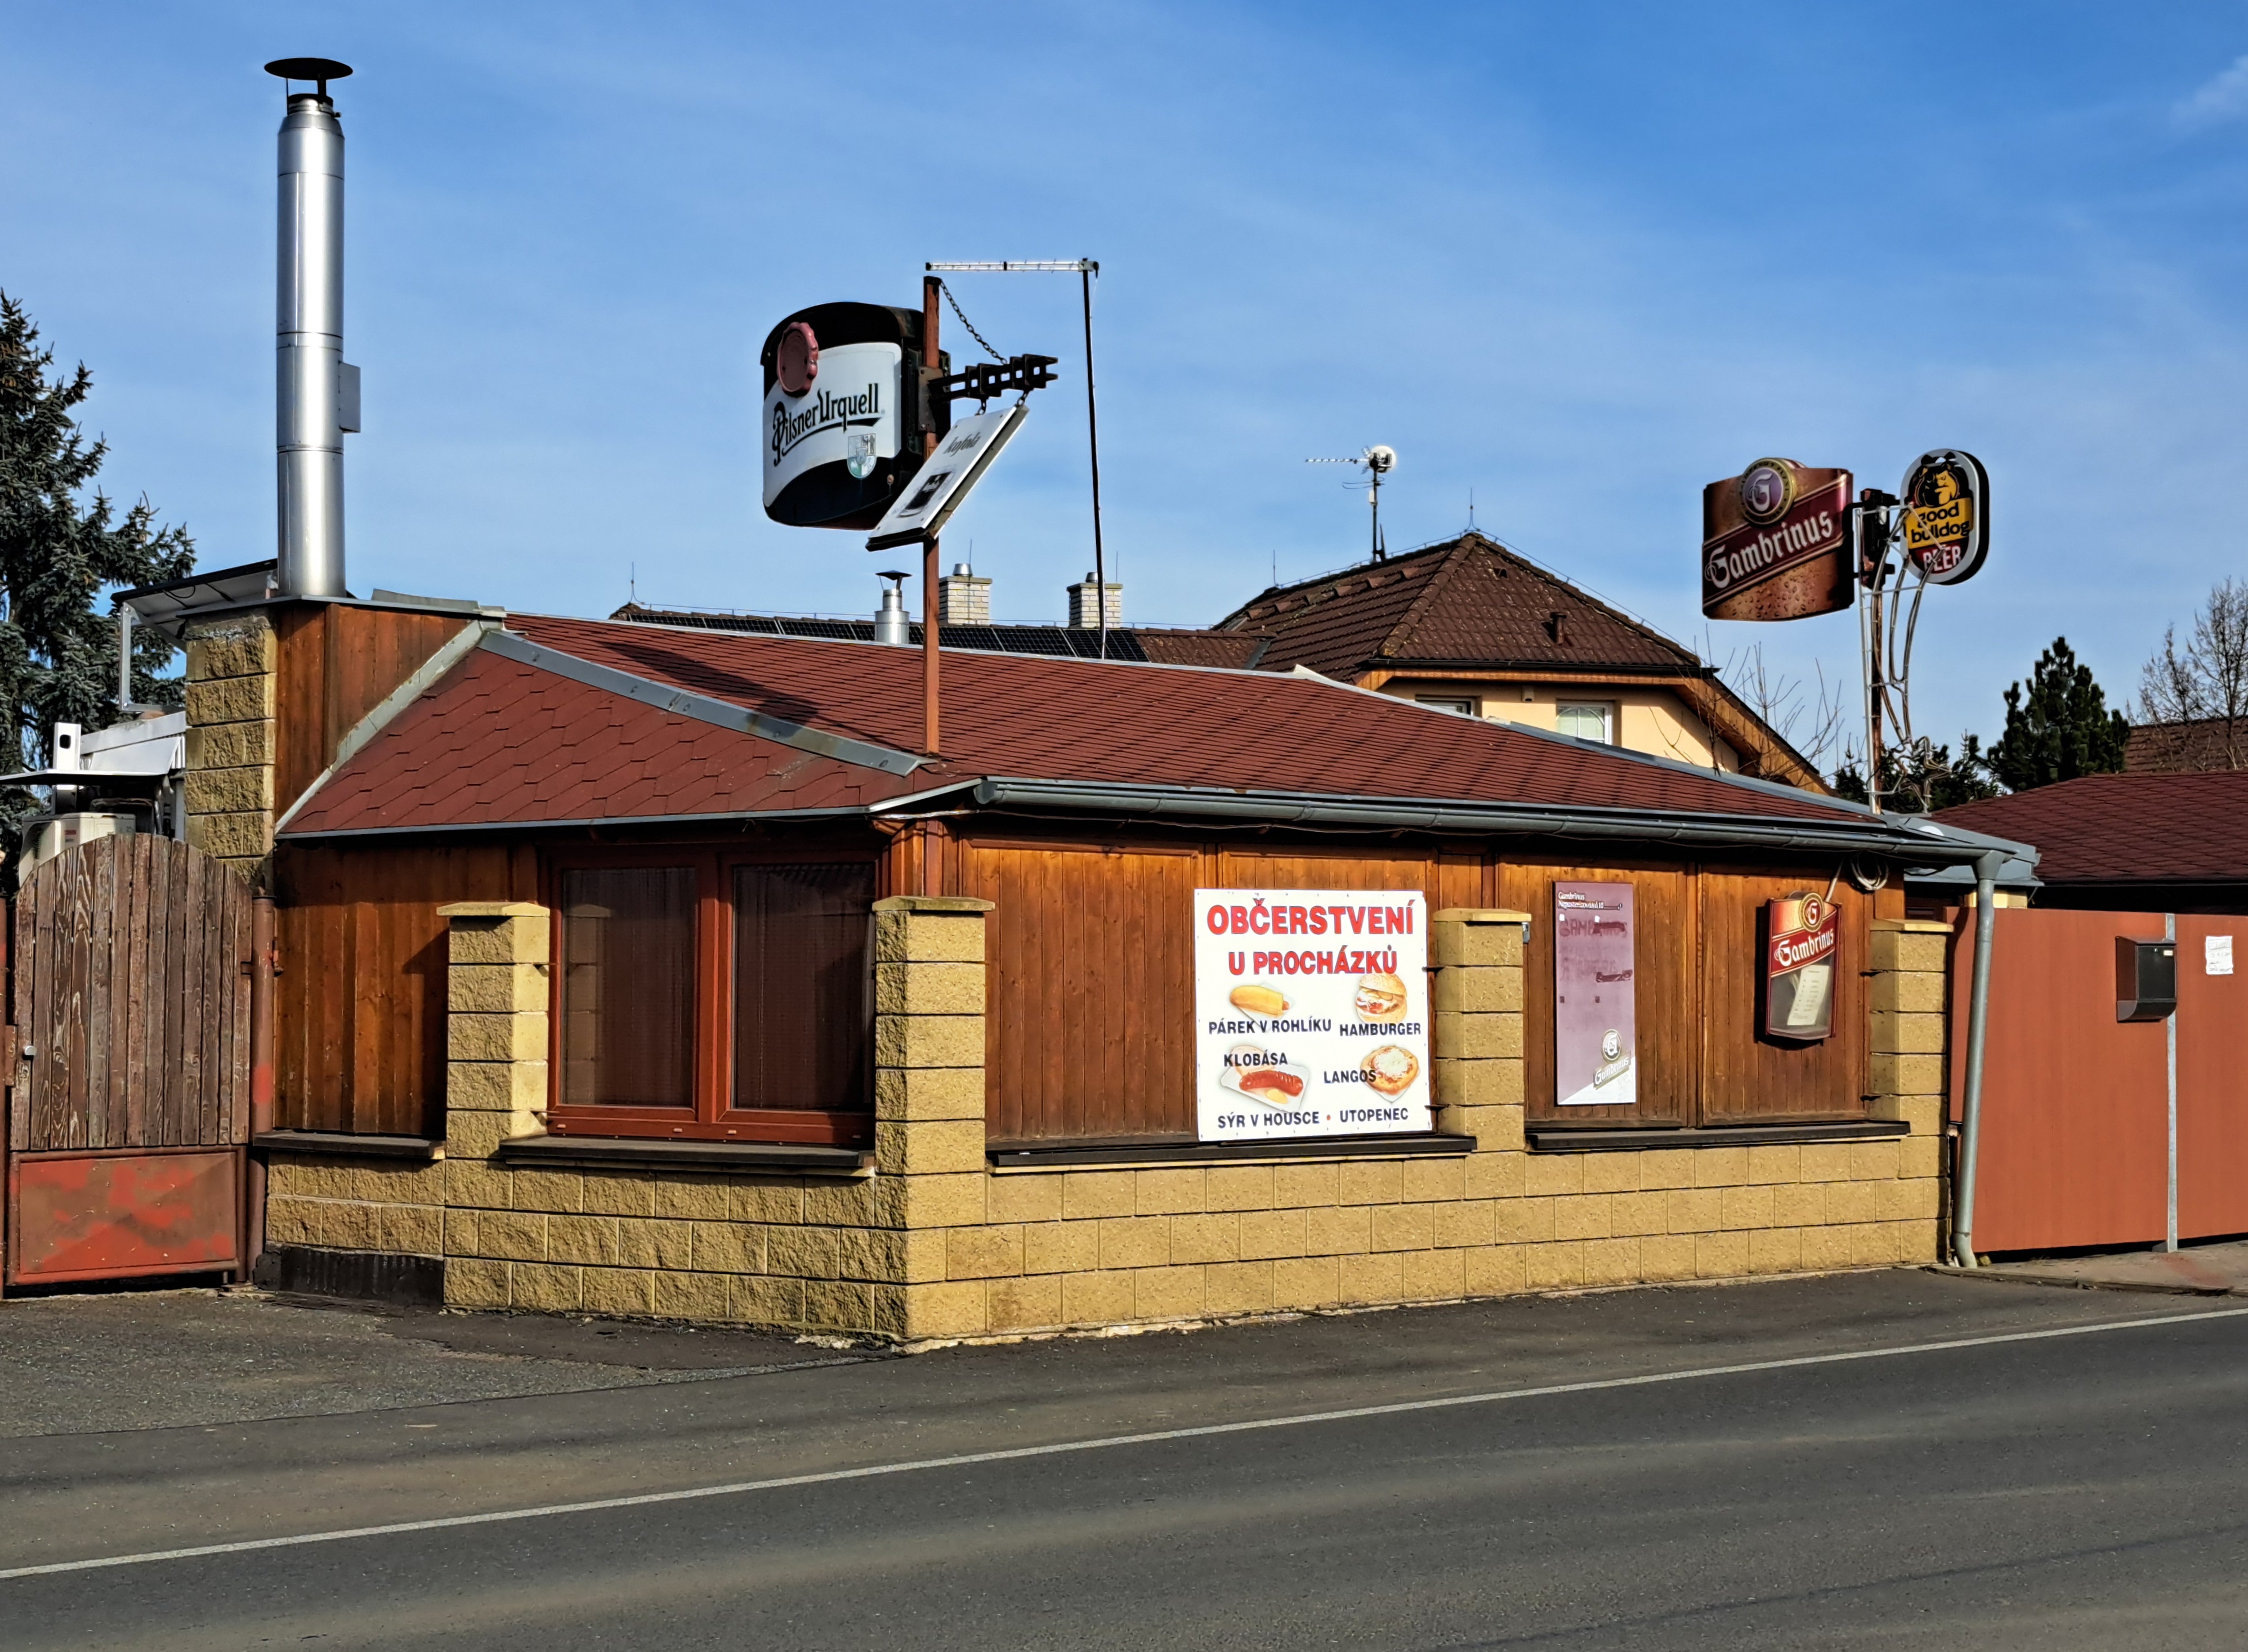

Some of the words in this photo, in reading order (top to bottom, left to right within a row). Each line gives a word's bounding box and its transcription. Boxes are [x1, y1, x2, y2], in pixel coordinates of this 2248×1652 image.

[772, 401, 819, 467] Pilsner
[817, 383, 879, 433] Urquell
[1918, 502, 1960, 528] good
[1911, 520, 1969, 544] bulldog
[1705, 511, 1833, 588] Gambrinus
[1558, 891, 1585, 901] Gambrinus
[1206, 898, 1416, 935] OBČERSTVENÍ
[1775, 929, 1834, 966] Gambrinus
[1228, 951, 1246, 975] U
[1253, 945, 1398, 975] PROCHÁZKŮ
[1209, 1019, 1255, 1035] PÁREK
[1259, 1020, 1268, 1033] V
[1272, 1015, 1332, 1033] ROHLÍKU
[1339, 1022, 1422, 1037] HAMBURGER
[1223, 1049, 1288, 1067] KLOBÁSA
[1324, 1069, 1376, 1084] LANGOS
[1594, 1056, 1629, 1085] Gambrinus
[1217, 1112, 1245, 1129] SÝR
[1250, 1114, 1259, 1127] V
[1264, 1111, 1320, 1126] HOUSCE
[1340, 1107, 1409, 1123] UTOPENEC
